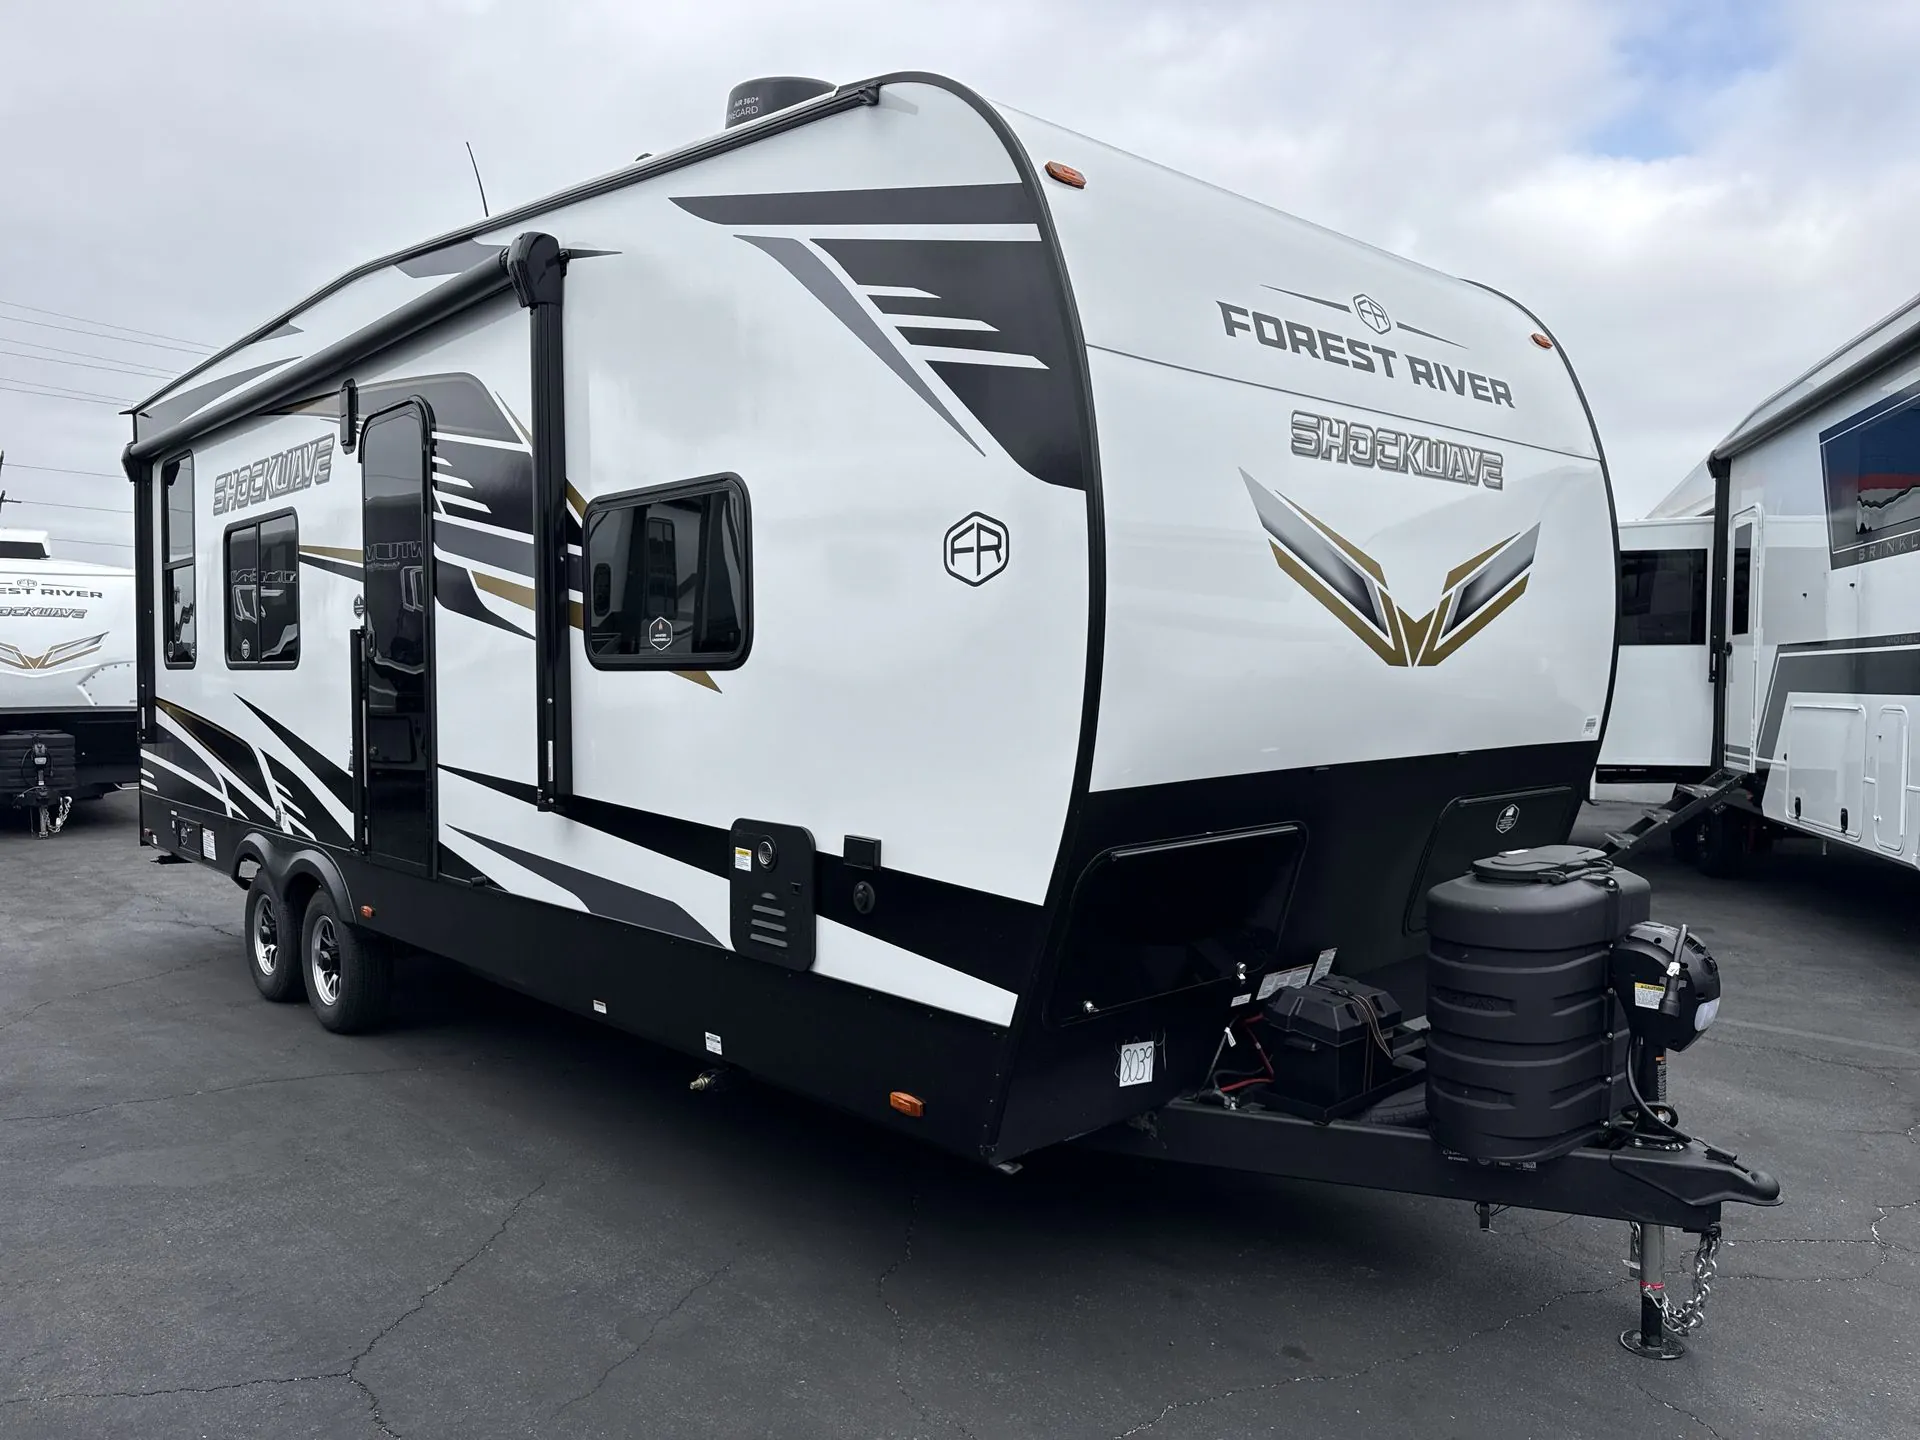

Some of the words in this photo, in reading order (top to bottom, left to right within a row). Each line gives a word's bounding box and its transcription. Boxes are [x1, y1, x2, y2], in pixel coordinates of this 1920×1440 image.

[1215, 300, 1397, 379] FOREST
[1404, 353, 1516, 409] RIVER
[212, 432, 336, 517] SHOCKWAVE
[1290, 409, 1504, 491] SHOCKWAVE
[40, 588, 104, 599] RIVER
[1121, 1045, 1153, 1083] 8039
